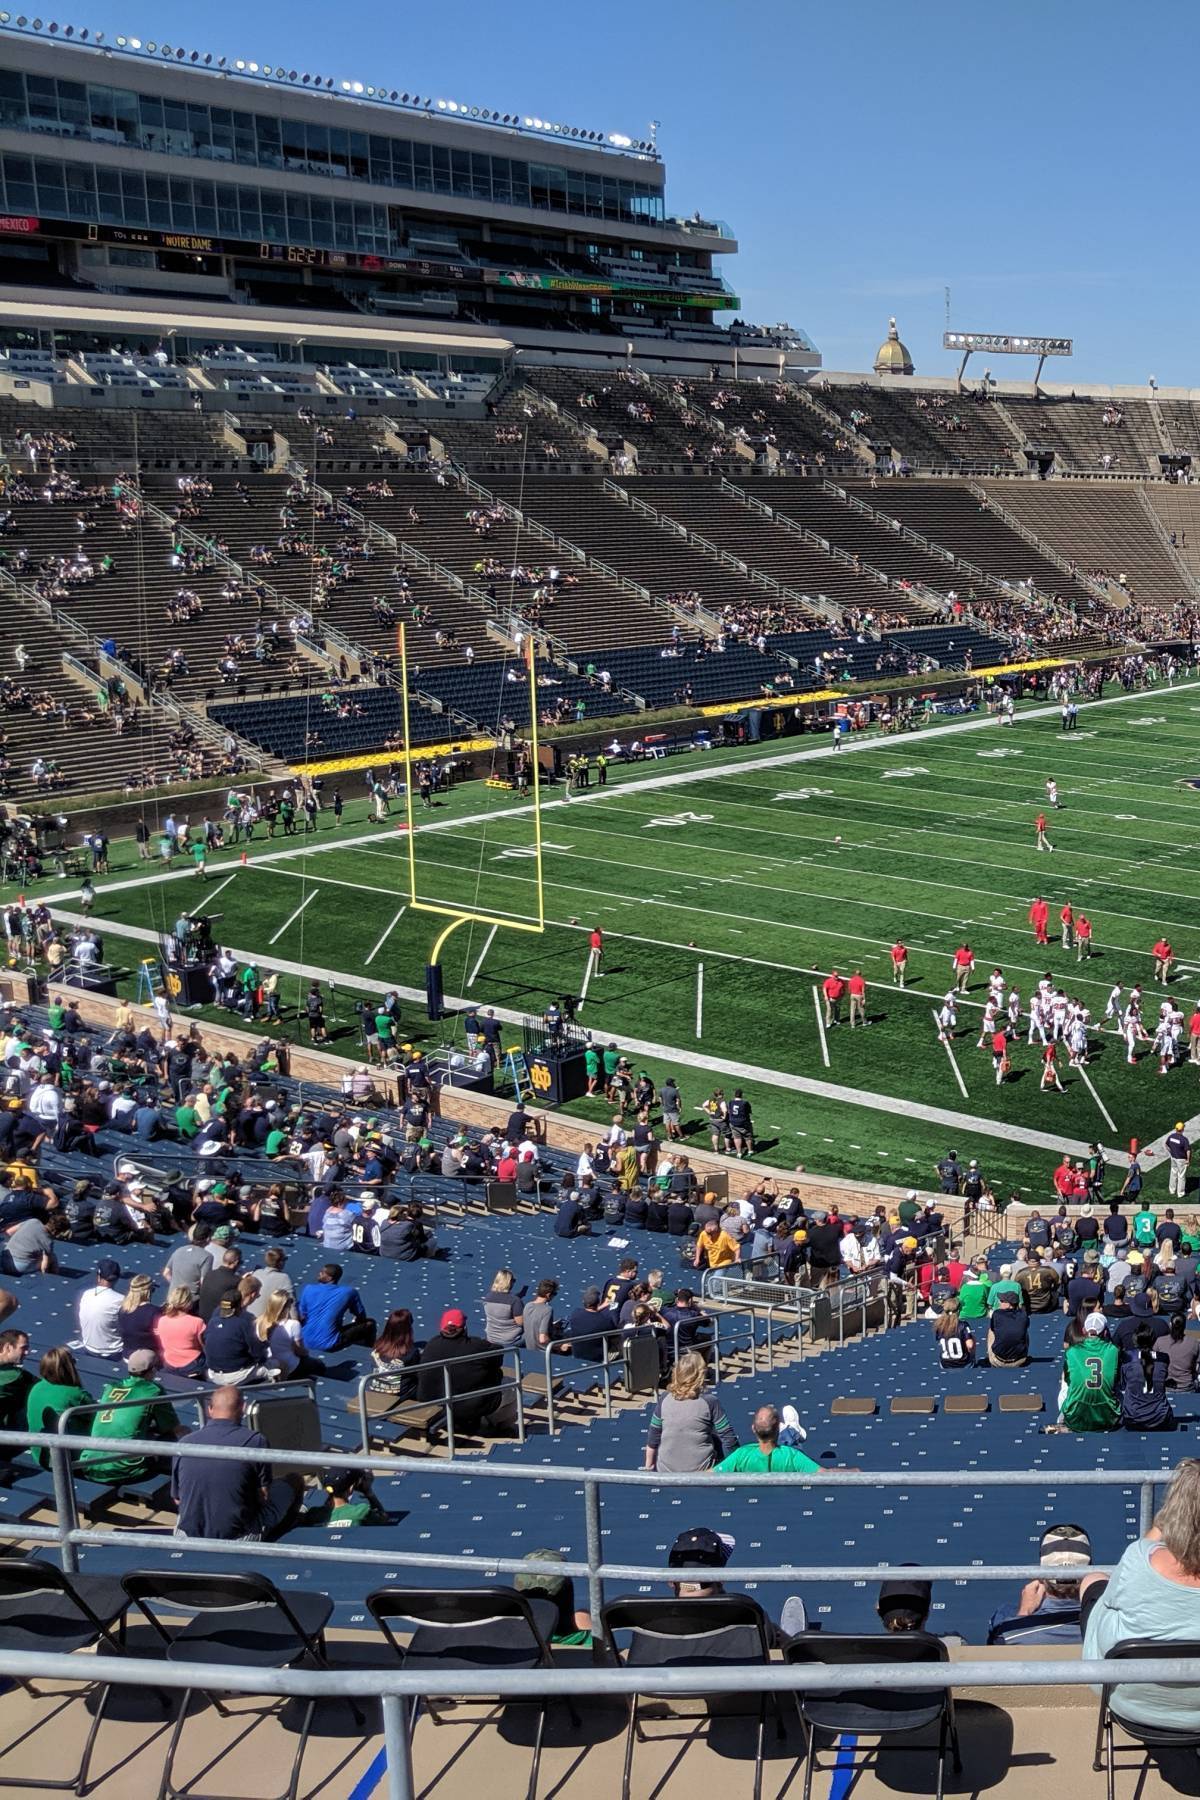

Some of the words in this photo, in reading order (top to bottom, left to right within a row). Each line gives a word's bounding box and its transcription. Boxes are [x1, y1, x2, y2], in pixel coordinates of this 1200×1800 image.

[166, 234, 191, 249] NOTRE
[191, 237, 213, 251] DAME
[1141, 1218, 1150, 1232] 3
[1027, 1272, 1043, 1290] 14
[607, 1284, 621, 1303] 5
[940, 1337, 963, 1359] 10
[1085, 1357, 1103, 1390] 3
[100, 1387, 131, 1423] 7
